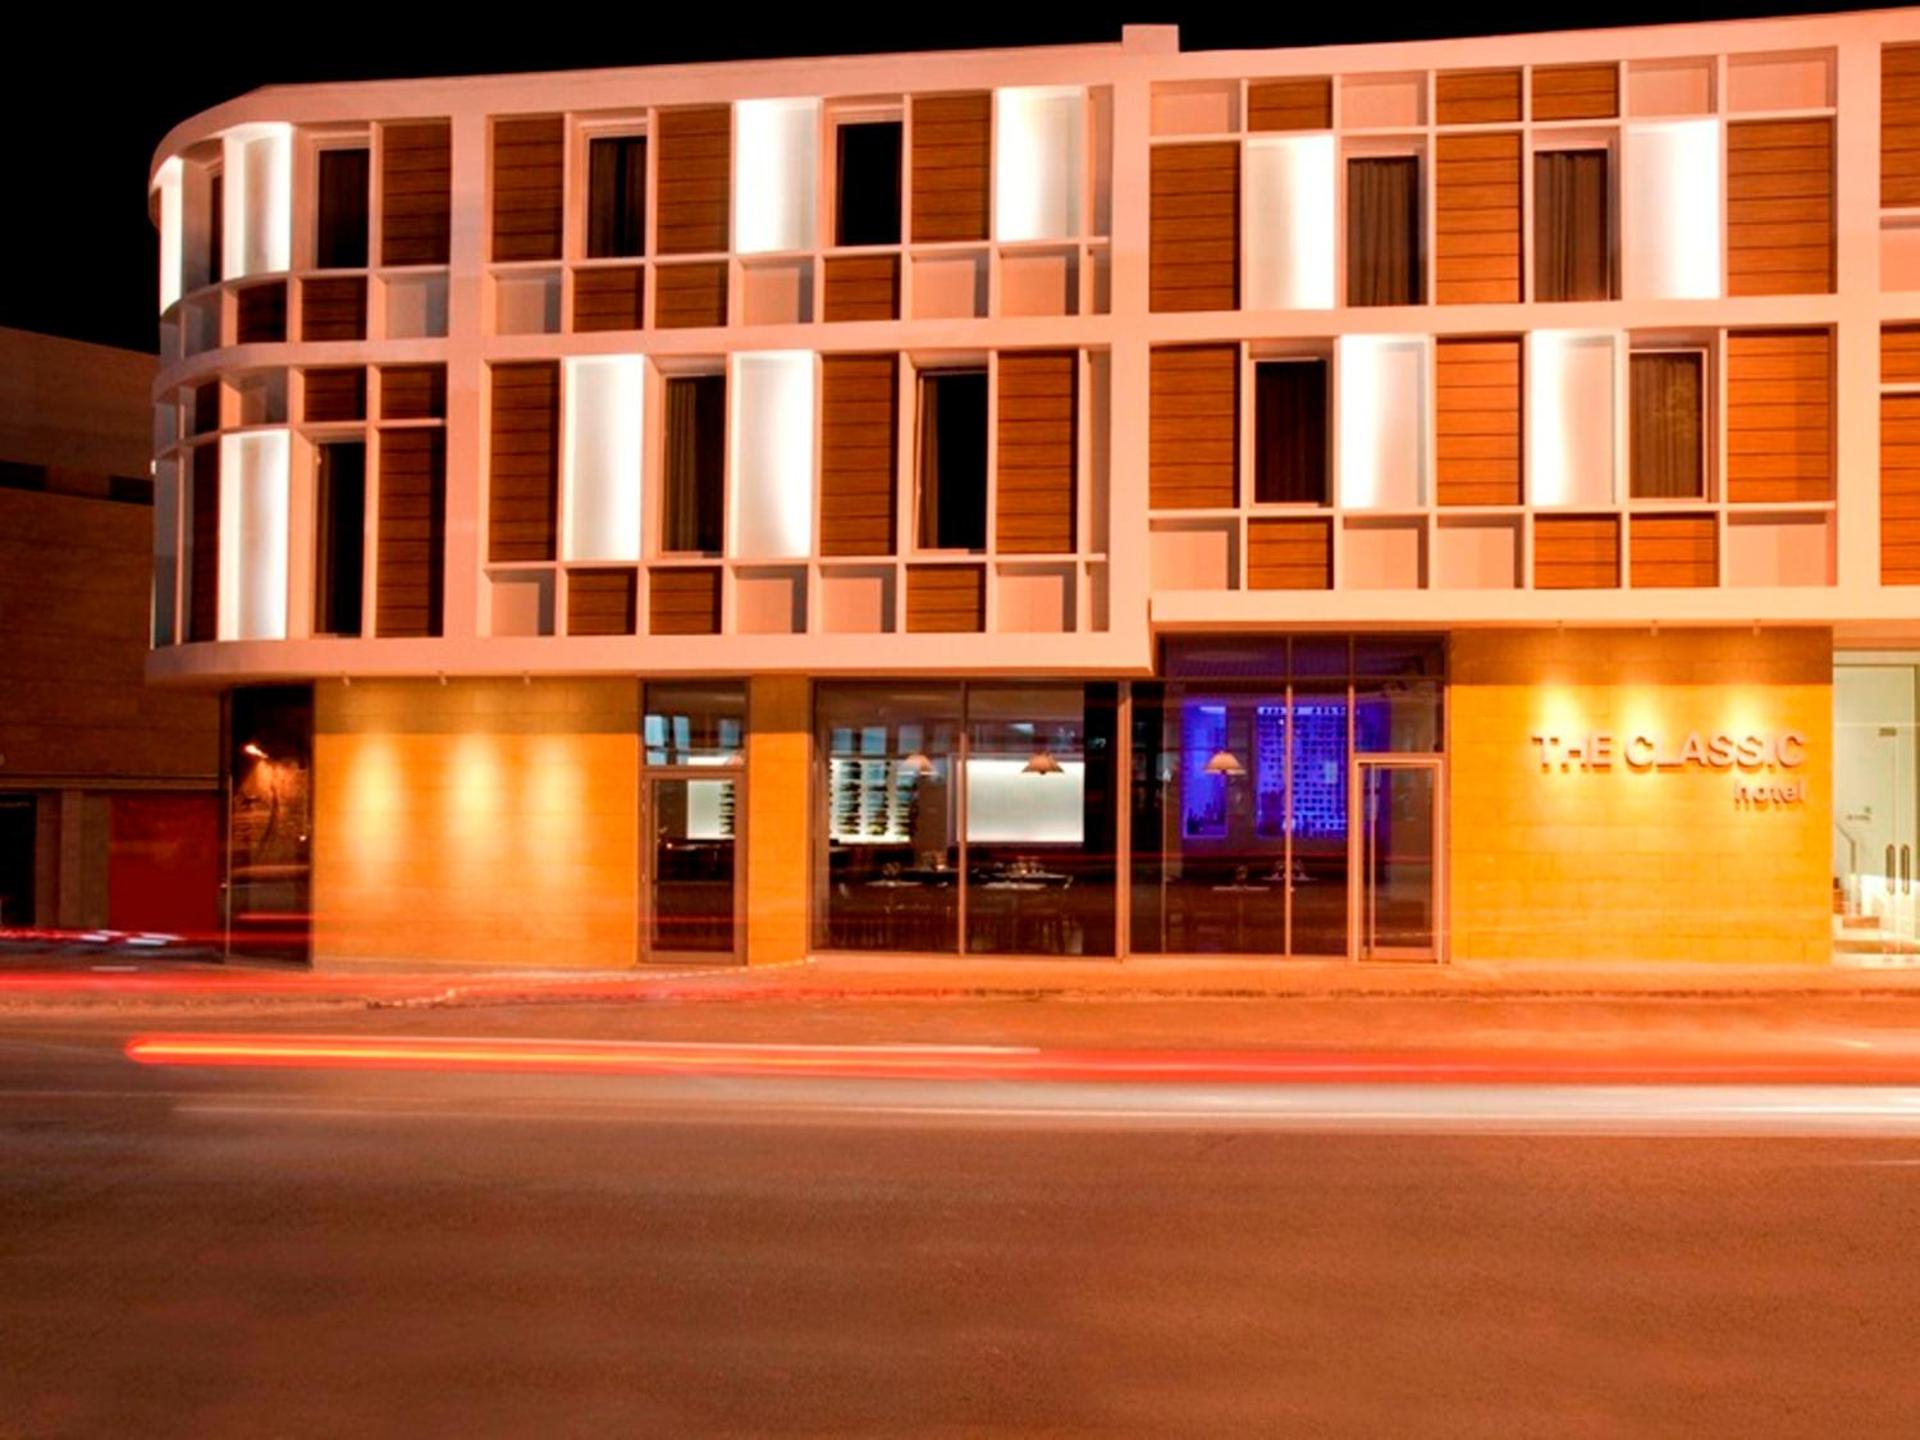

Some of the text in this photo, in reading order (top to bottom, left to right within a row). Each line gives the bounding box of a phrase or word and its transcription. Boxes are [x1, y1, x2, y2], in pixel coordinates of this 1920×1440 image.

[1531, 733, 1805, 769] THE CLASSIC
[1735, 778, 1804, 806] hotel
